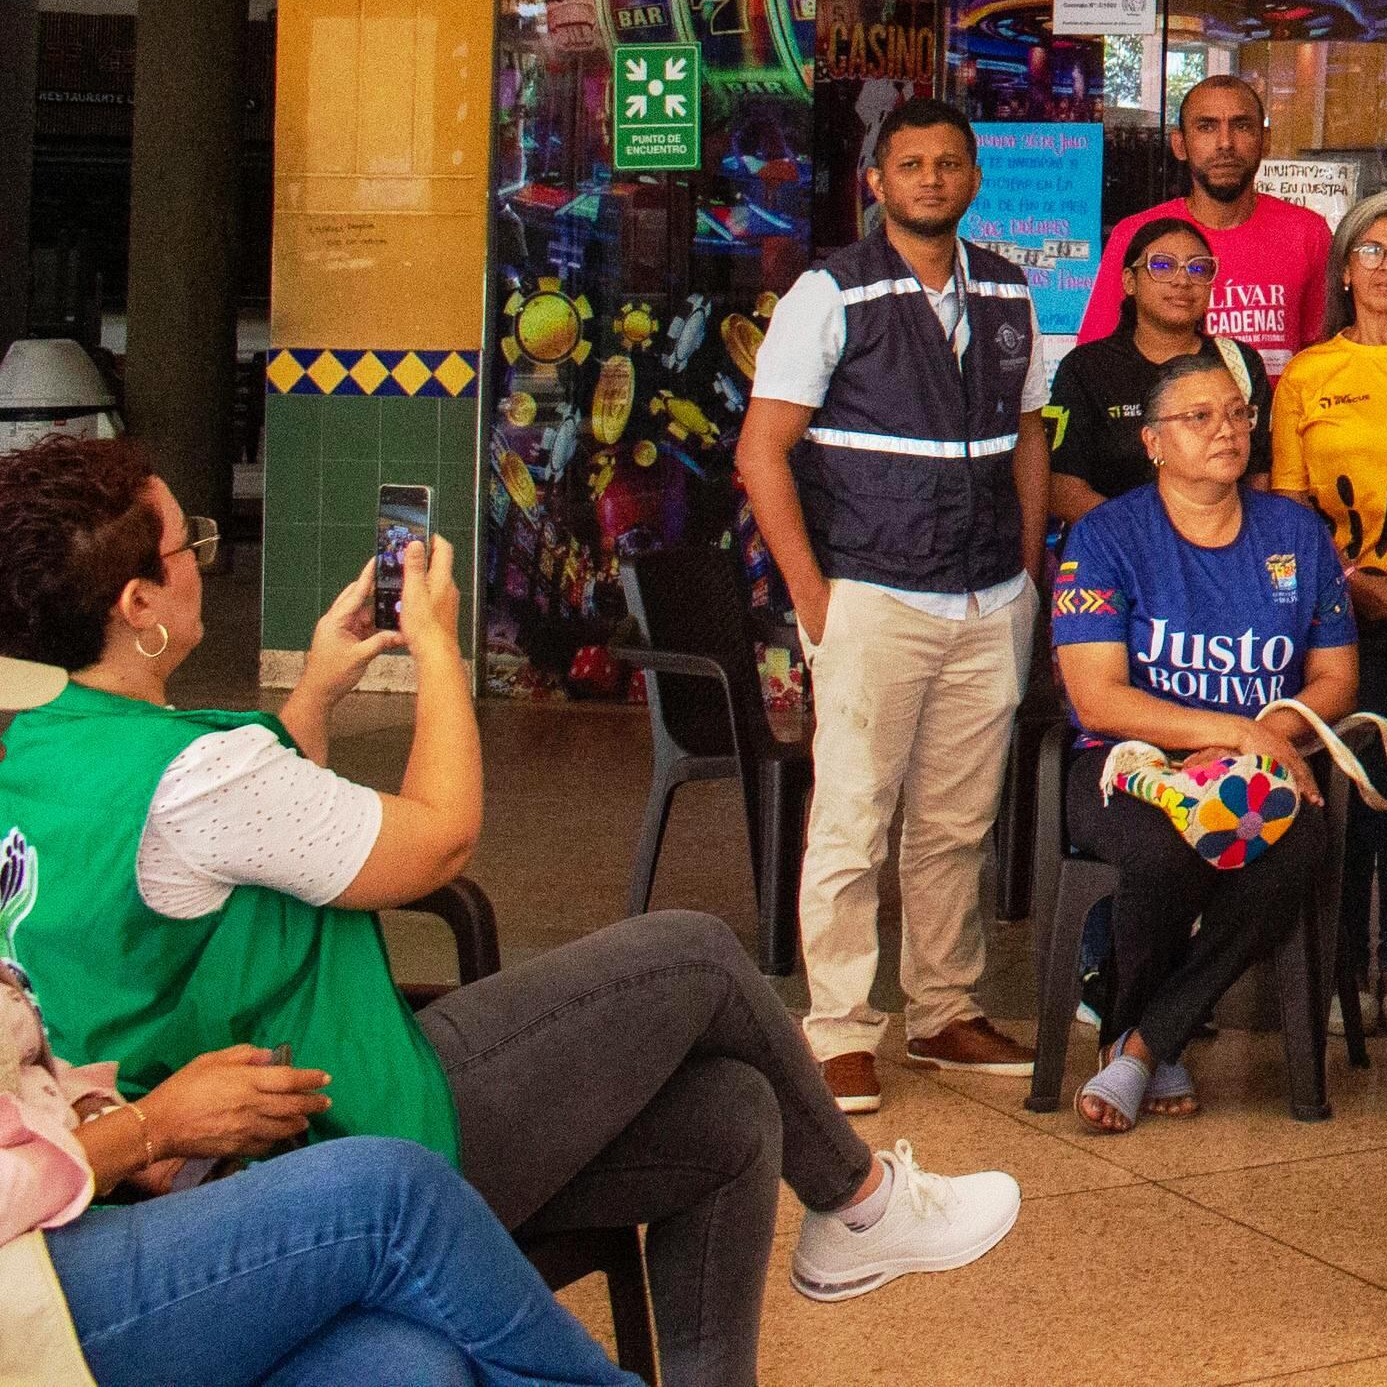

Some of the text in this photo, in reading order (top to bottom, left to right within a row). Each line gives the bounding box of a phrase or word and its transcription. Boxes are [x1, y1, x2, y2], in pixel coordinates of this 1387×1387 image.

[616, 5, 665, 28] BAR
[828, 22, 934, 80] CASINO
[626, 144, 687, 155] ENCUENTRO
[631, 134, 681, 144] PUNTO DE
[1281, 182, 1348, 197] EN NUESTRA
[1208, 279, 1287, 309] LÍVAR
[1206, 308, 1285, 335] CADENAS
[1137, 618, 1294, 675] Justo
